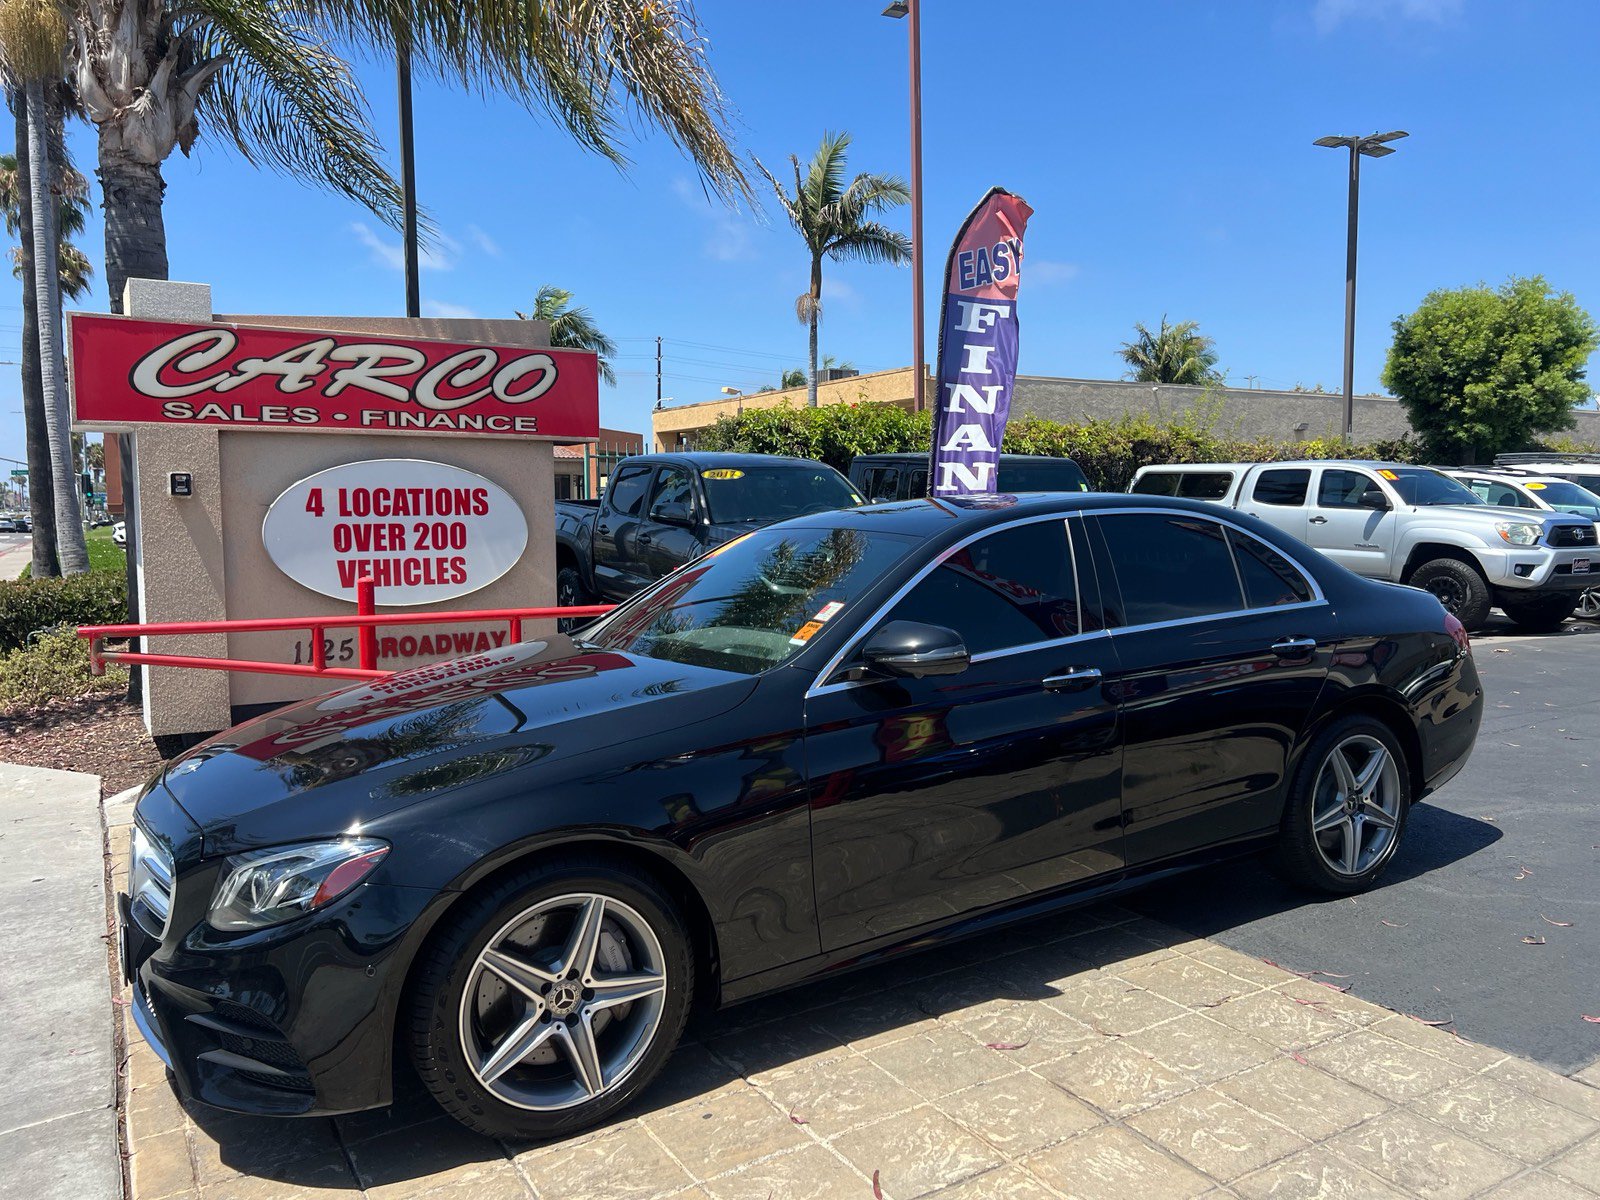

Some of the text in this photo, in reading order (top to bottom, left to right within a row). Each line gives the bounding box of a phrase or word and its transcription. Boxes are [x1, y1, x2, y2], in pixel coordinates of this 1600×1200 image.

[958, 237, 1022, 290] EASY
[129, 329, 559, 409] CARCO
[161, 401, 538, 432] SALES FINANCE
[709, 470, 737, 479] 2017
[305, 487, 489, 518] 4 LOCATIONS
[333, 522, 467, 553] OVER 200
[336, 556, 468, 588] VEHICLES
